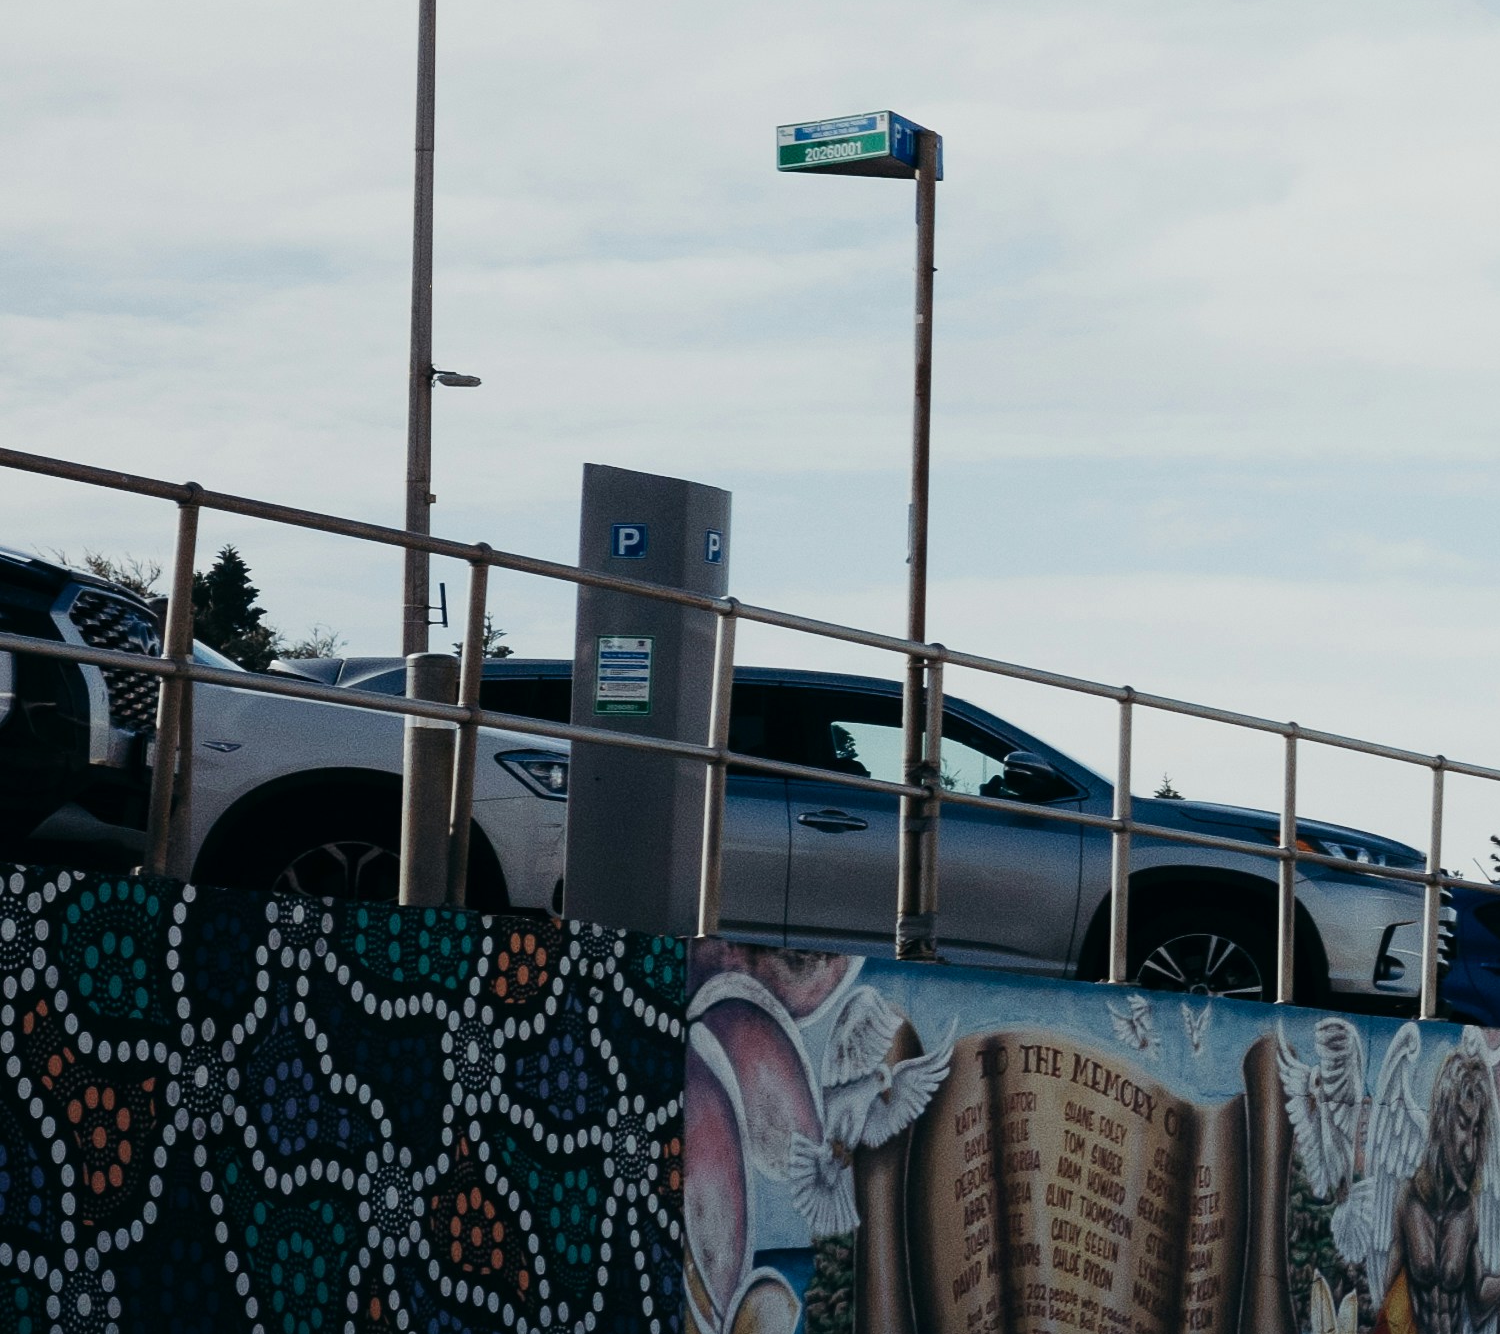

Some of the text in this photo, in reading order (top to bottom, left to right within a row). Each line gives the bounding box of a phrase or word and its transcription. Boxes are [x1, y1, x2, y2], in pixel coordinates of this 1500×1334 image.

[805, 142, 862, 162] 20260001
[618, 528, 641, 555] P
[708, 533, 721, 560] P
[1018, 1044, 1062, 1079] THE
[1070, 1053, 1158, 1125] MEMORY
[1098, 1114, 1128, 1147] FOLEY
[1064, 1129, 1124, 1176] TOM SINGER
[1051, 1217, 1082, 1248] CATHY
[1079, 1195, 1132, 1241] THOMPSON
[1082, 1258, 1114, 1292] BYRON
[1026, 1283, 1047, 1301] 202
[1048, 1286, 1079, 1307] people
